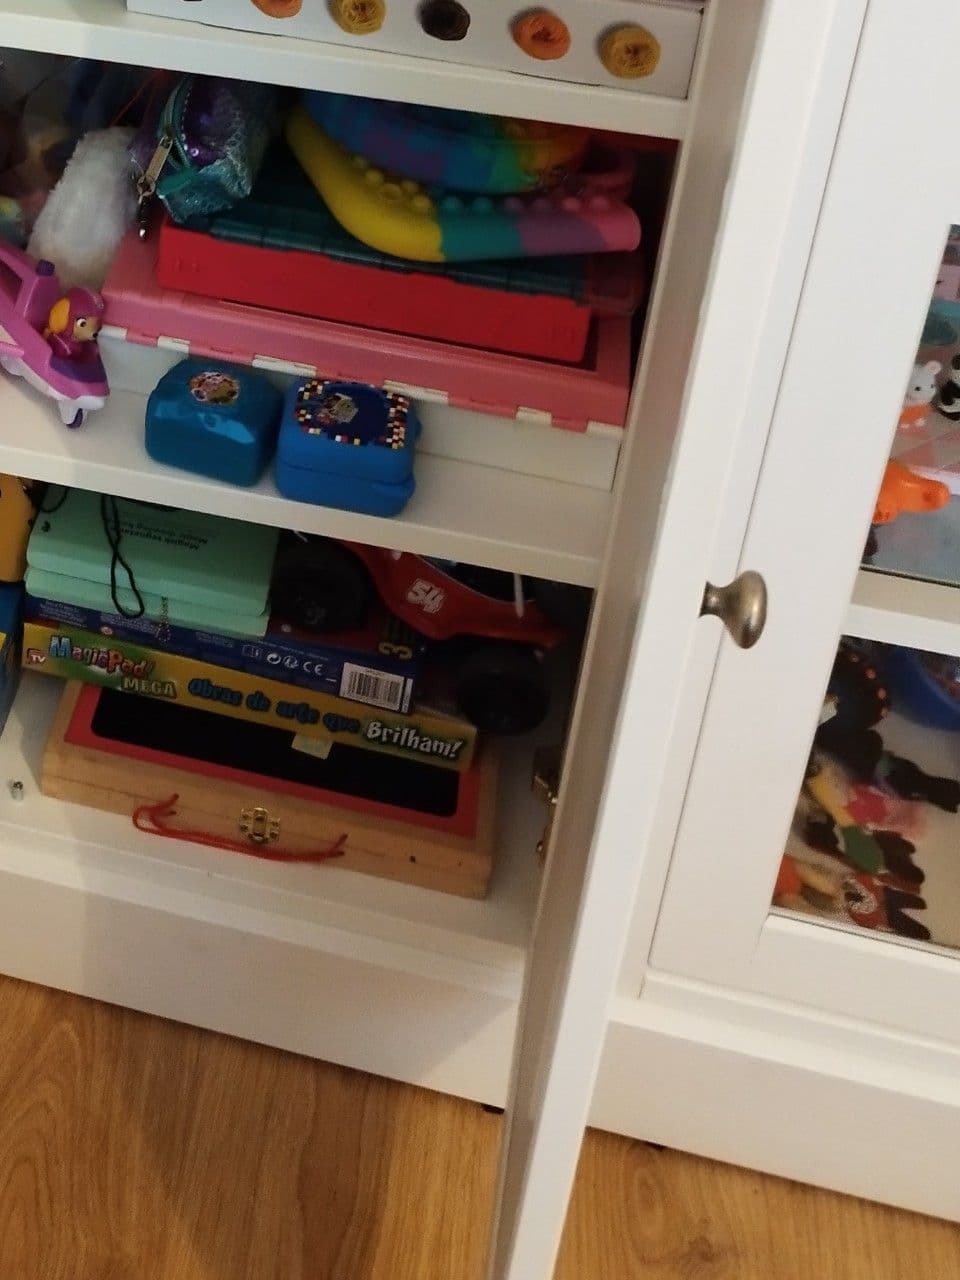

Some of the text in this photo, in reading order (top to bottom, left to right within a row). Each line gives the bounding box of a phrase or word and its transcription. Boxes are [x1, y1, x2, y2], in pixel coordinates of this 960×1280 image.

[123, 677, 177, 699] MEGA
[189, 679, 242, 706] Obras
[246, 691, 271, 711] de
[366, 721, 464, 758] Brilham!
